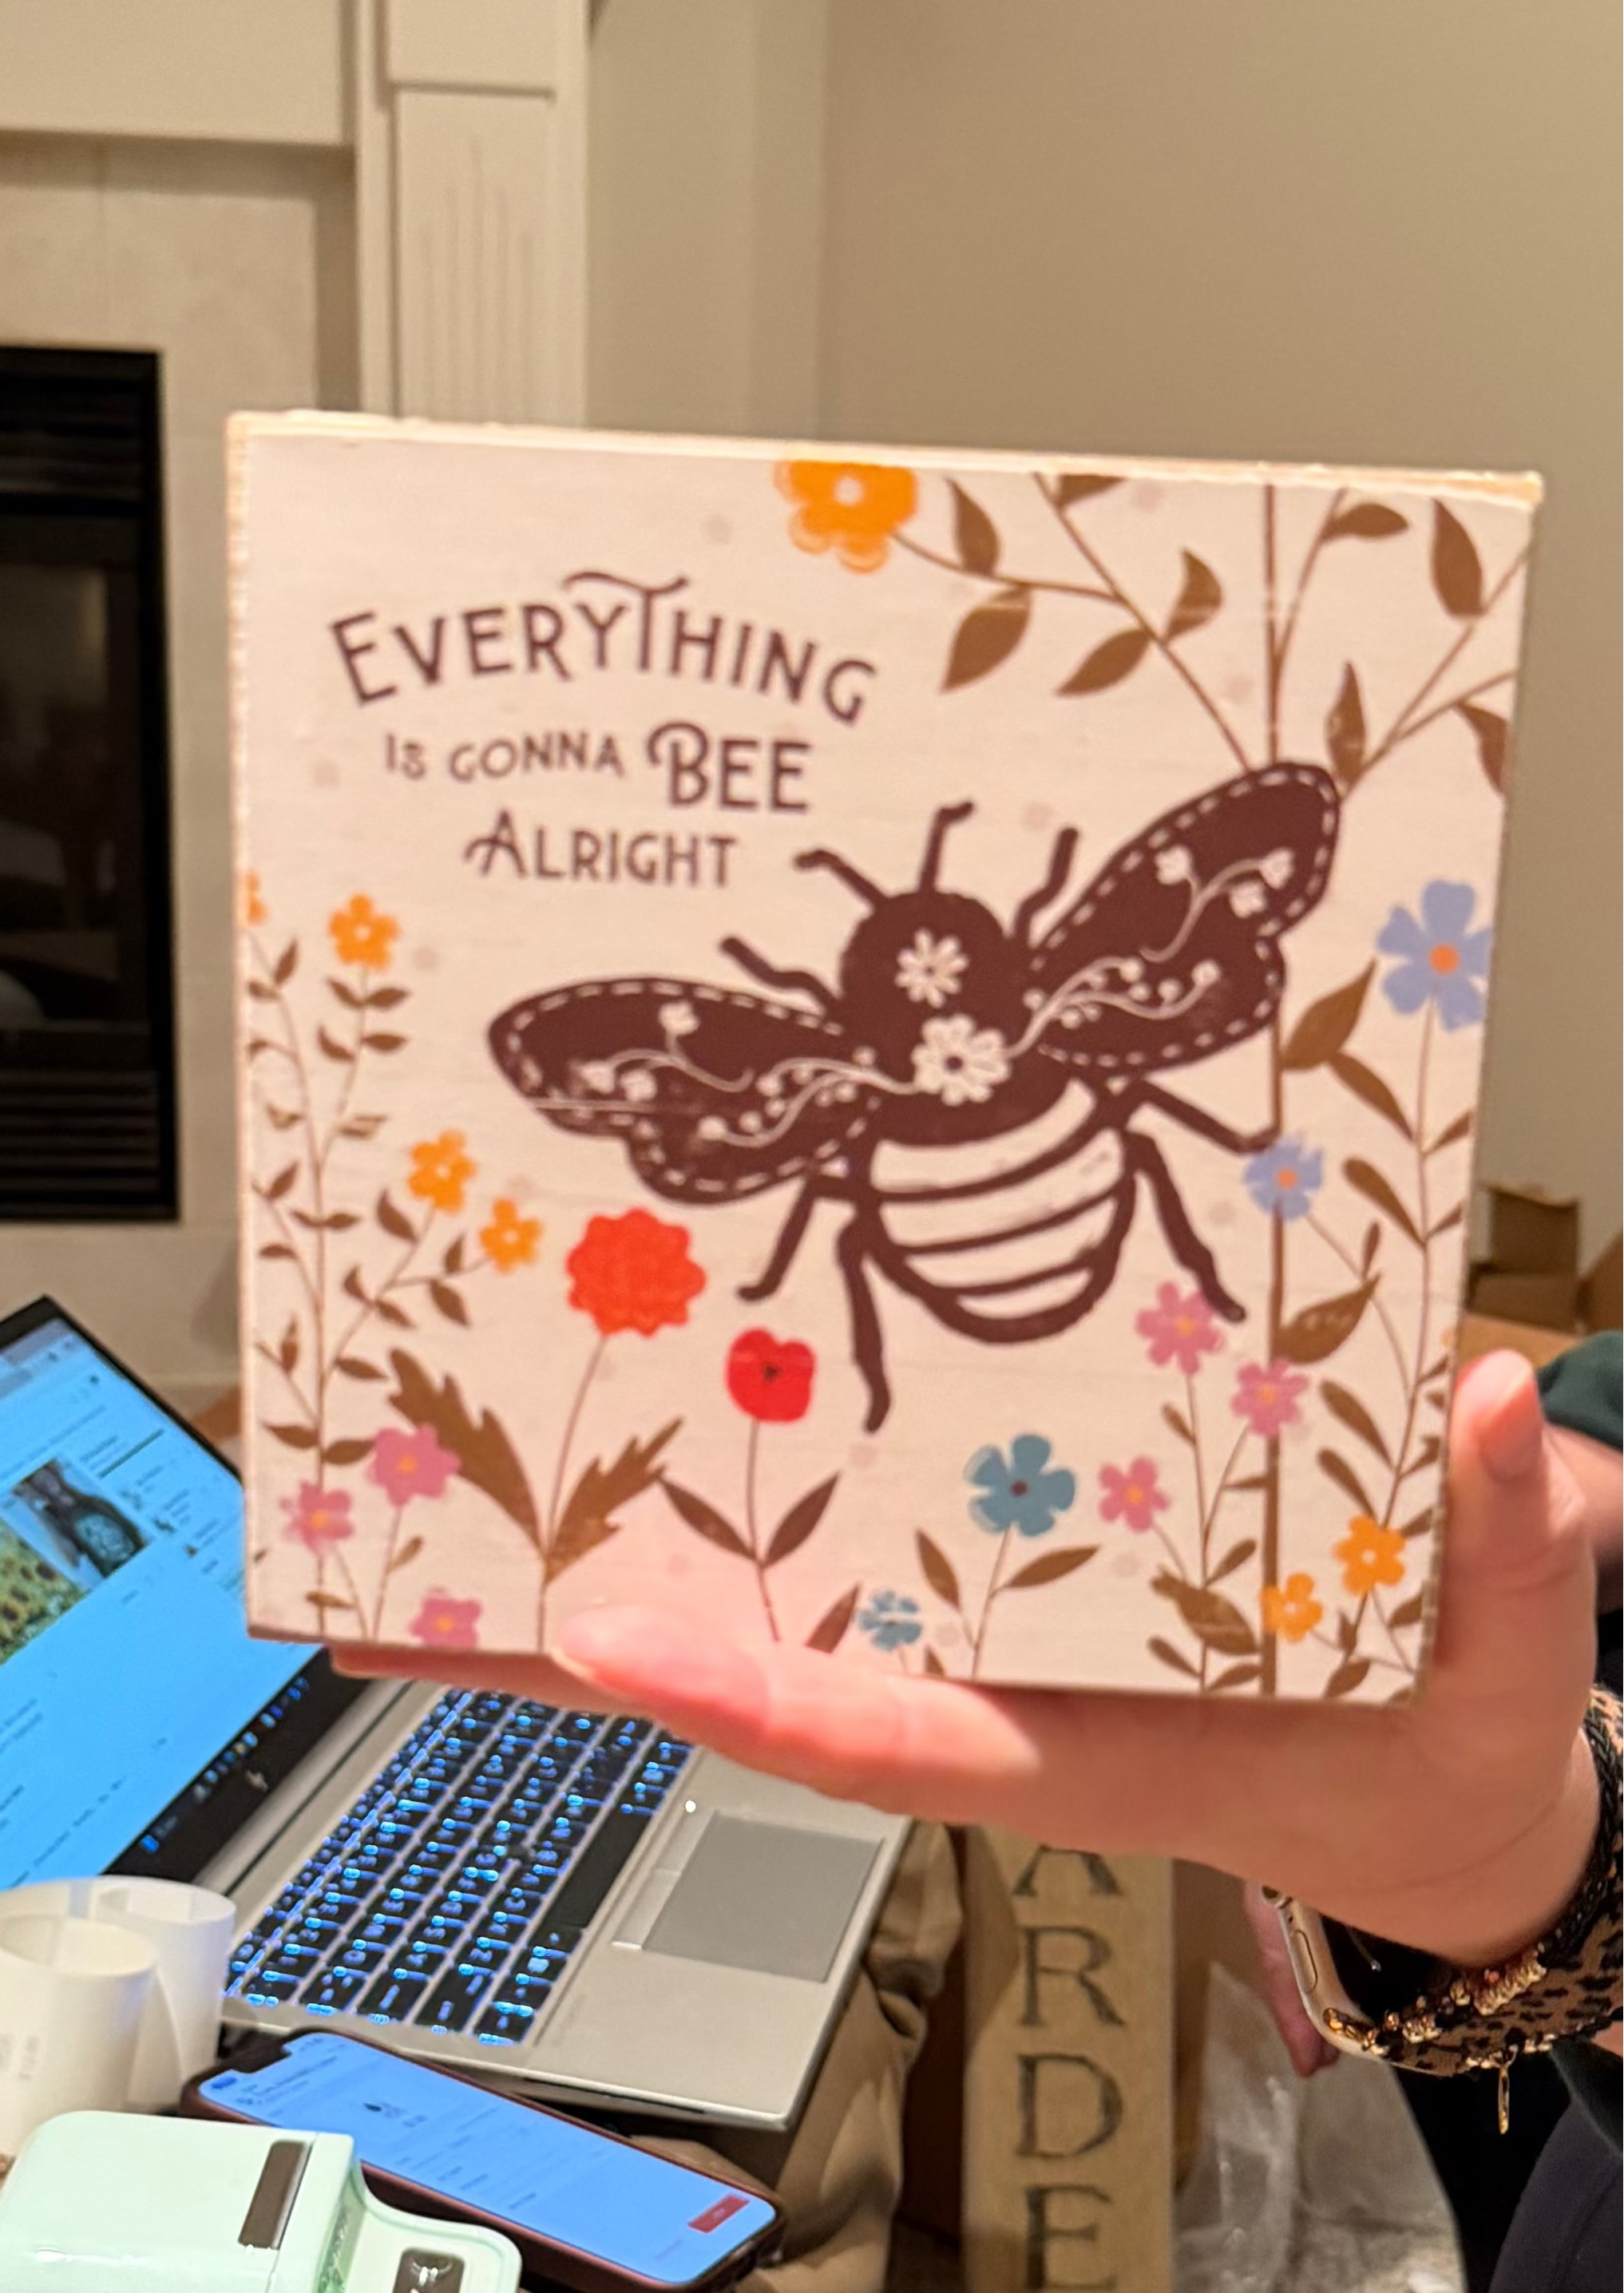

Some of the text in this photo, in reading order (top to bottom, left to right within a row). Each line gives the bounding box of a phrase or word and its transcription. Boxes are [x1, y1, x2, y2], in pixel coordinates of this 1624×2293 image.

[327, 569, 877, 726] EVERYTHING
[385, 720, 813, 814] IS GONNA BEE
[462, 808, 738, 888] ALRIGHT
